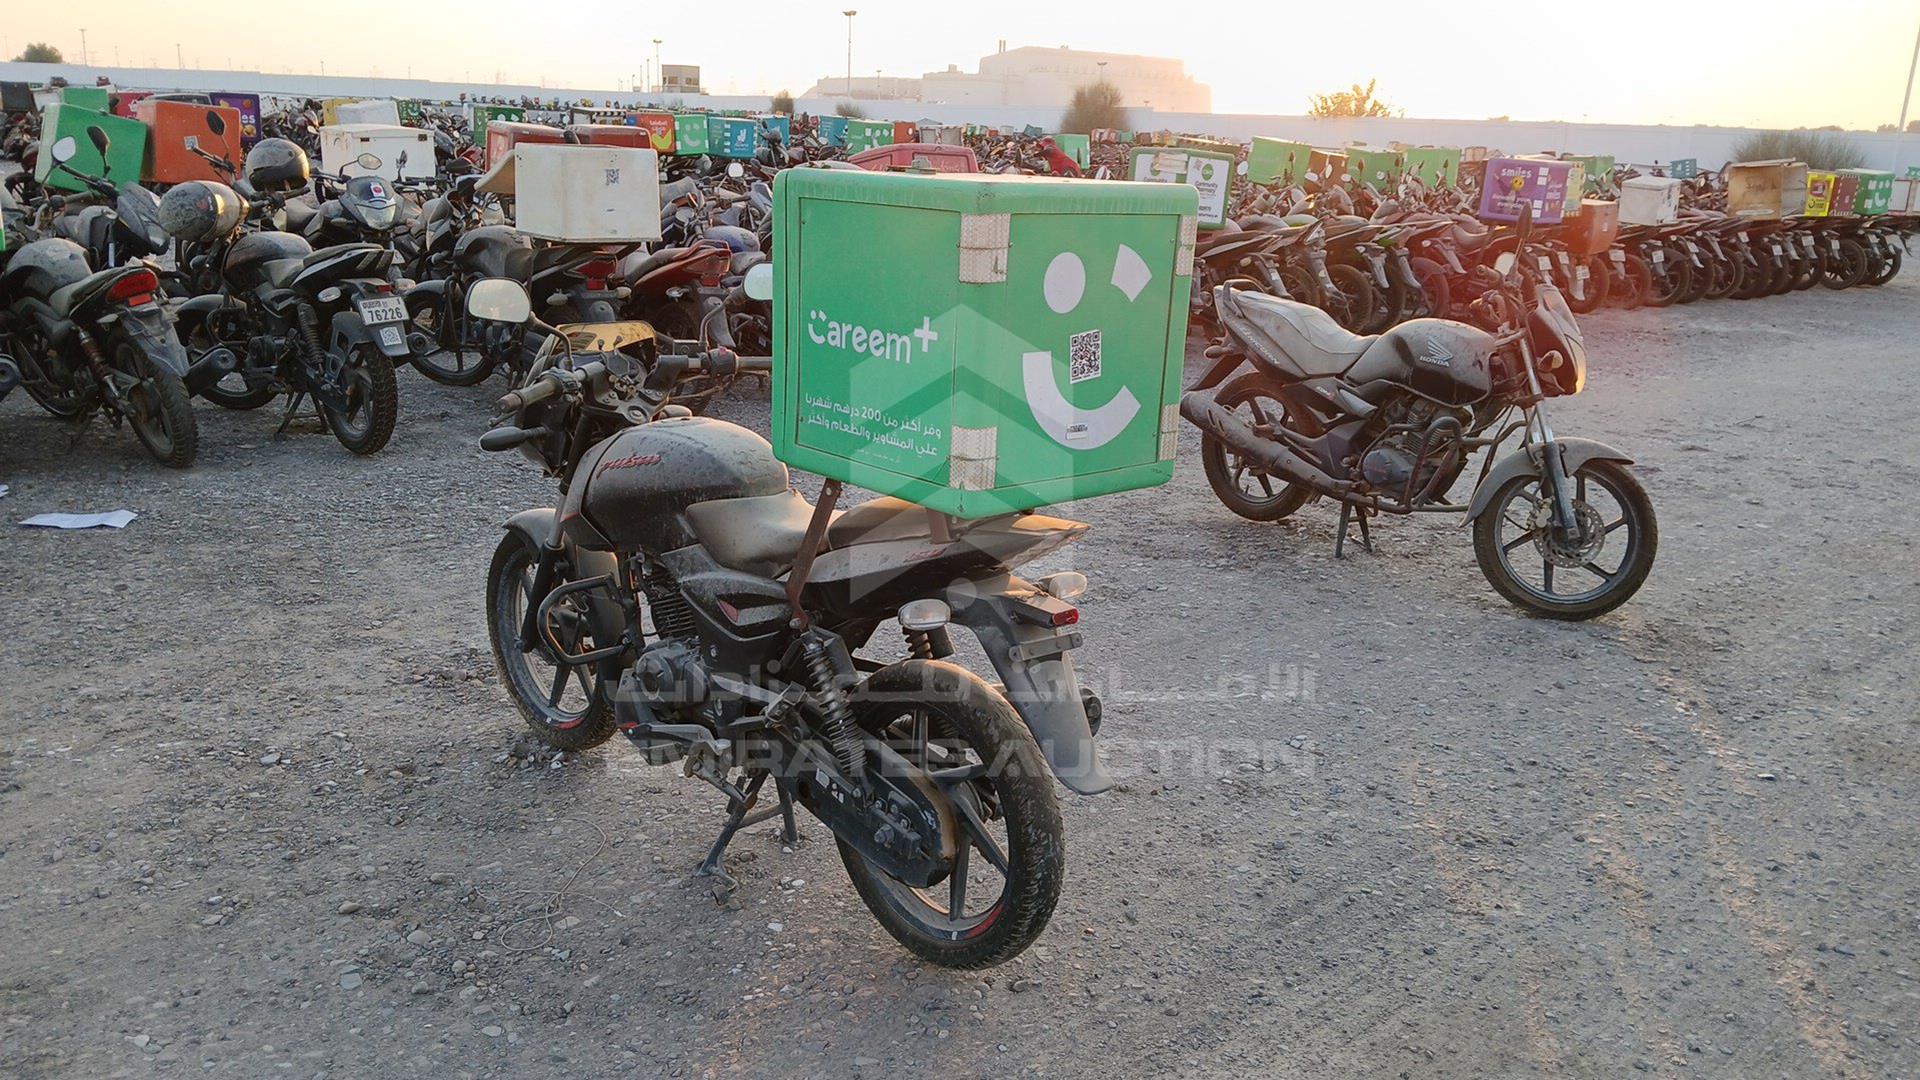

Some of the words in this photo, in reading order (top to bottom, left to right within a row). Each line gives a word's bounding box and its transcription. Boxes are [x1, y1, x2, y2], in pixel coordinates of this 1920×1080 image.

[1501, 166, 1532, 178] smiles
[367, 306, 403, 322] 76226
[1420, 355, 1450, 367] HONDA
[833, 404, 860, 417] درهم
[861, 406, 881, 422] 200
[883, 412, 898, 427] من
[872, 431, 914, 449] المشاوير
